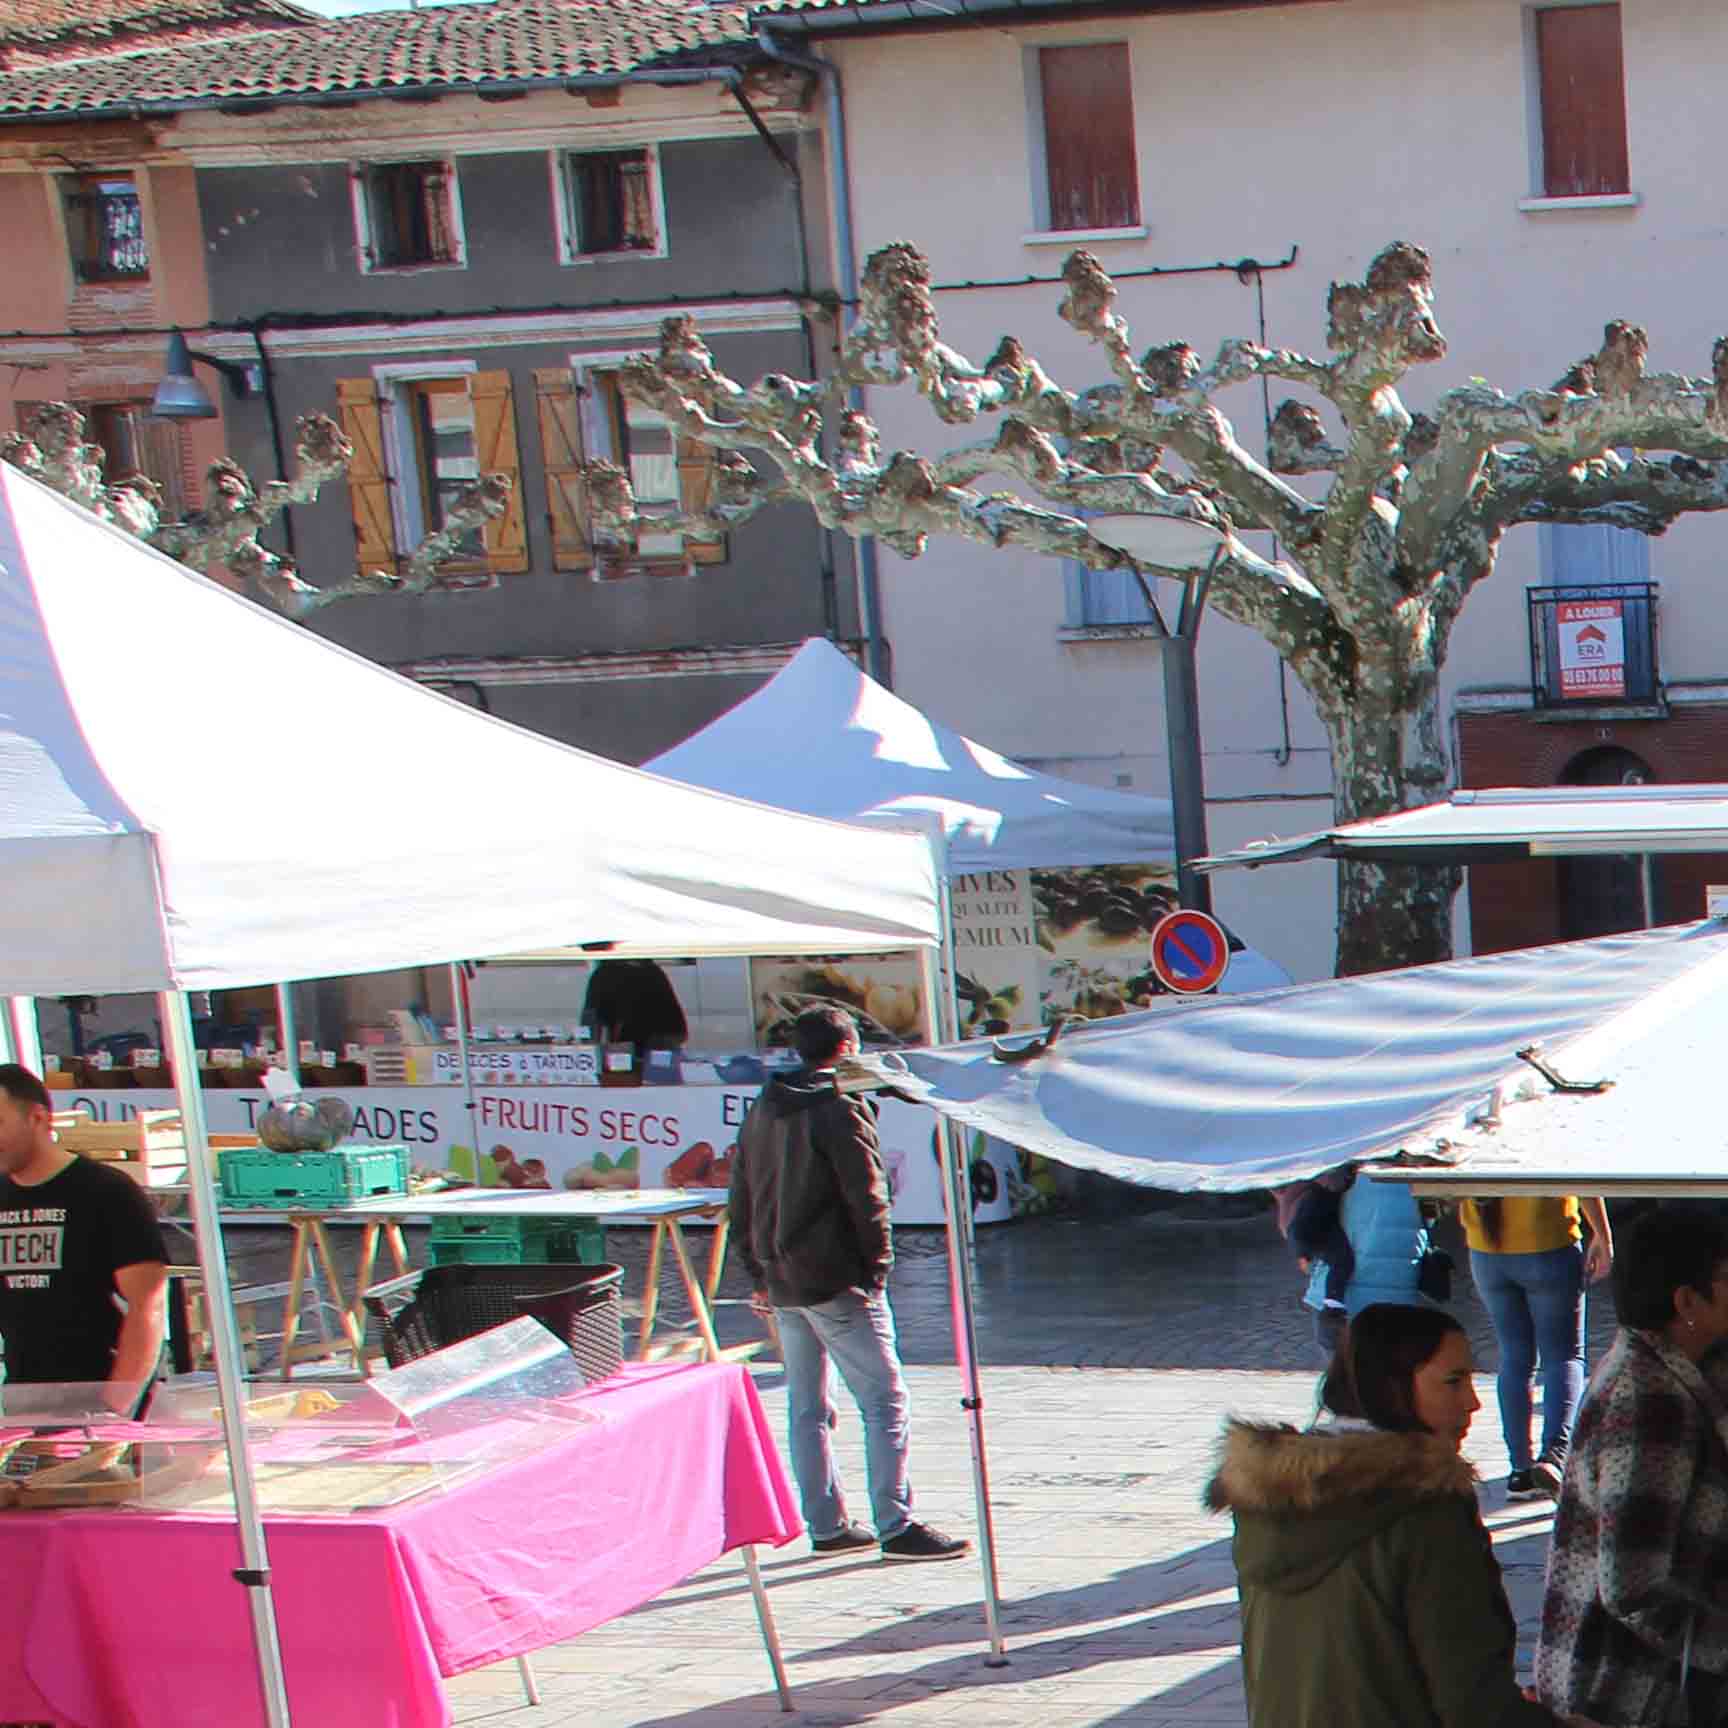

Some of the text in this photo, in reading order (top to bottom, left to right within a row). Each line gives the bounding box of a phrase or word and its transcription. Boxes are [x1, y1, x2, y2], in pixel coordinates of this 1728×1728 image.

[1577, 644, 1606, 657] ERA
[437, 1051, 512, 1071] DEICES
[239, 1097, 440, 1144] TADES
[480, 1096, 681, 1147] FRUITS SECS
[0, 1231, 58, 1264] TECH
[7, 1274, 50, 1289] VICTORY
